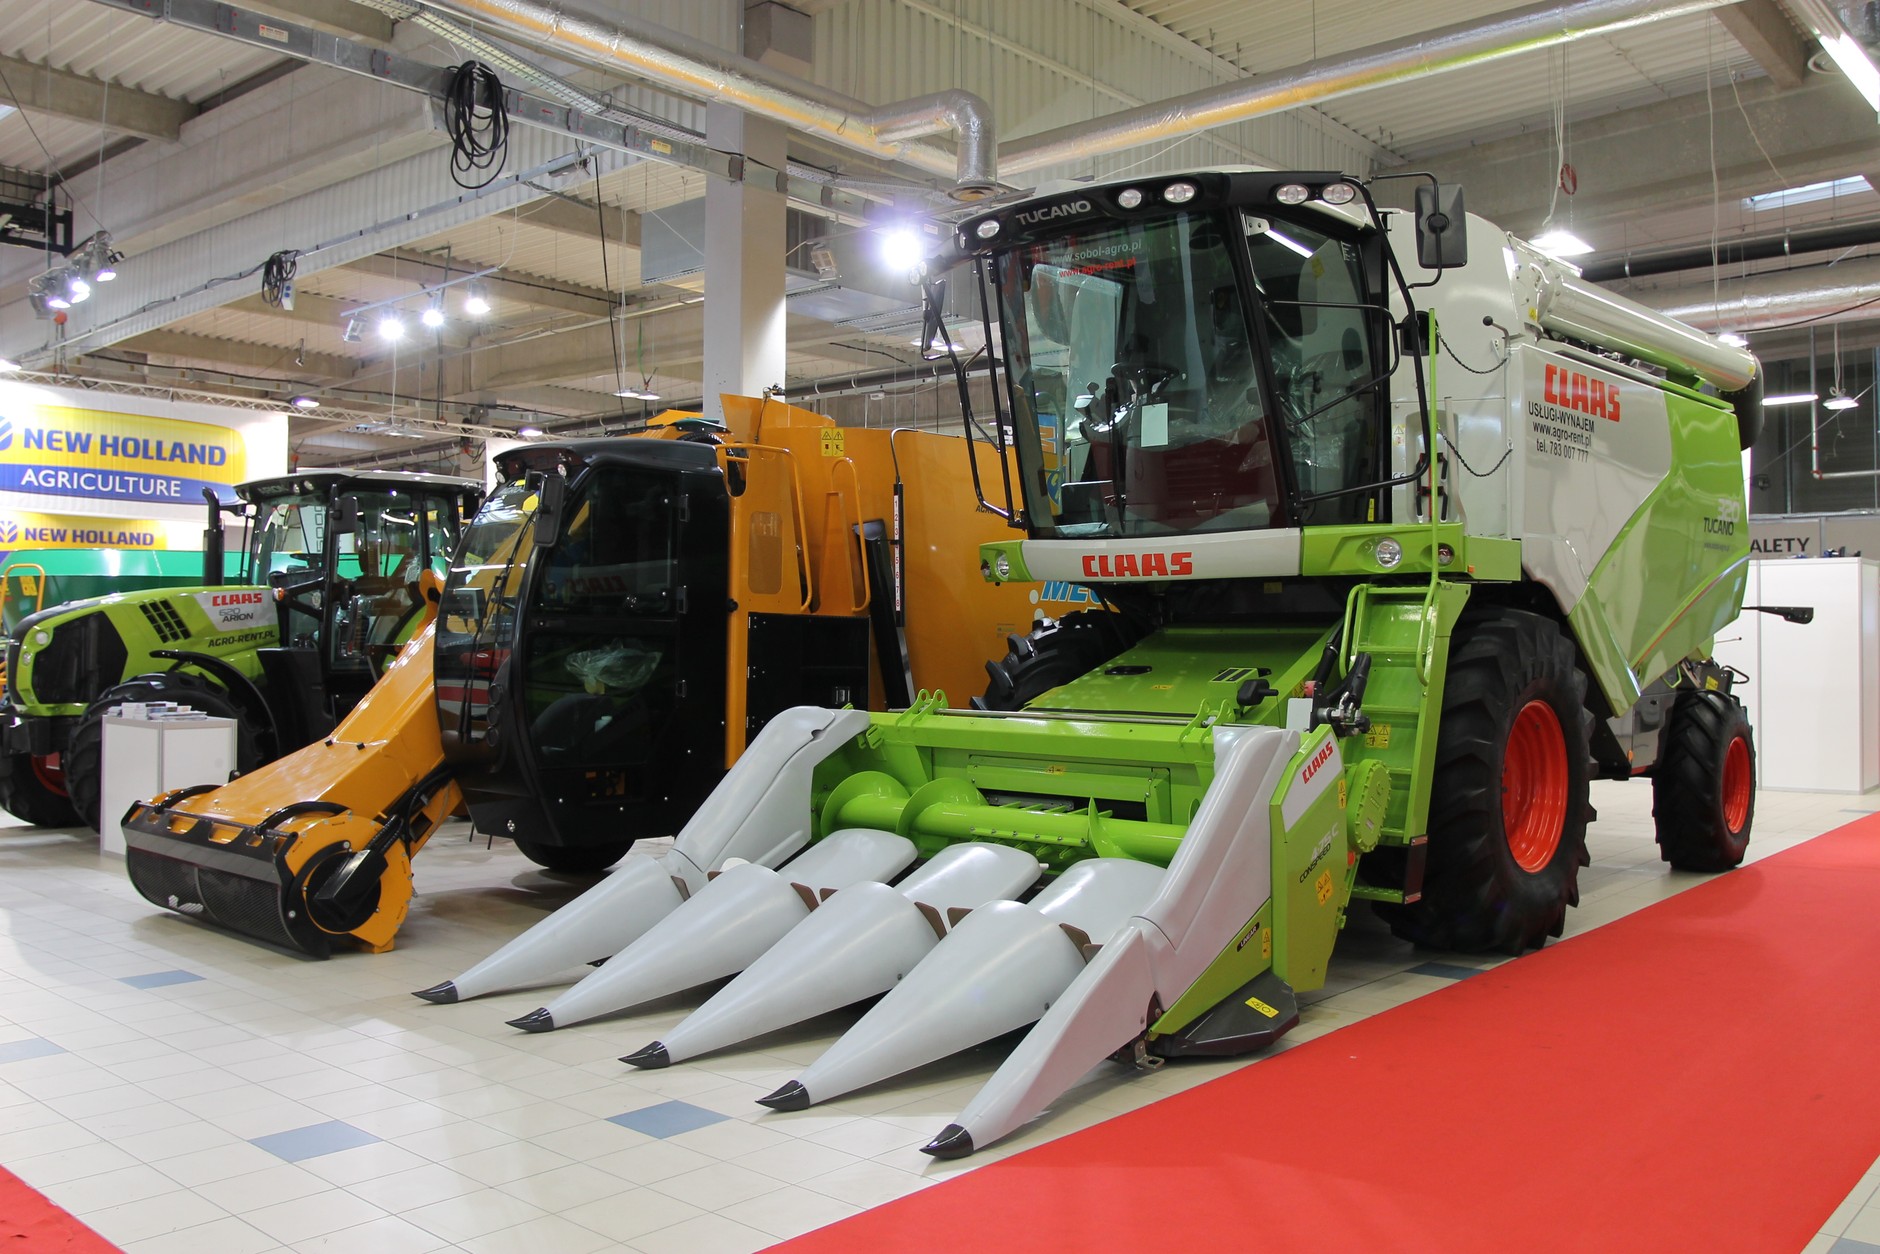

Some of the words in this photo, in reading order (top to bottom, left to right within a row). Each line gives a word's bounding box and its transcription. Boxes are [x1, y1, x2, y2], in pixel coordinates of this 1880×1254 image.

[1015, 200, 1092, 225] TUCANO
[1051, 239, 1142, 265] www.sobol-agro.pl
[1059, 256, 1137, 278] www.agro-rent.pl
[1544, 363, 1621, 423] CLAAS
[1528, 400, 1595, 433] USŁUGI-WYNAJEM
[23, 428, 93, 454] NEW
[99, 435, 227, 466] HOLLAND
[1533, 421, 1592, 449] www.agro-rent.pl
[1536, 438, 1548, 453] tel.
[1549, 441, 1562, 457] 783
[1563, 444, 1576, 460] 007
[1577, 448, 1589, 463] 777
[21, 468, 182, 497] AGRICULTURE
[24, 527, 67, 543] NEW
[72, 529, 155, 546] HOLLAND
[1704, 517, 1735, 536] TUCANO
[1750, 537, 1810, 553] ALETY
[1081, 552, 1193, 577] CLAAS
[212, 592, 263, 607] CLAAS
[219, 607, 241, 616] 620
[222, 612, 254, 623] ARION
[208, 630, 276, 647] AGRO-RENT.PL
[1302, 740, 1334, 784] CLAAS
[1299, 842, 1331, 884] CONSPEED
